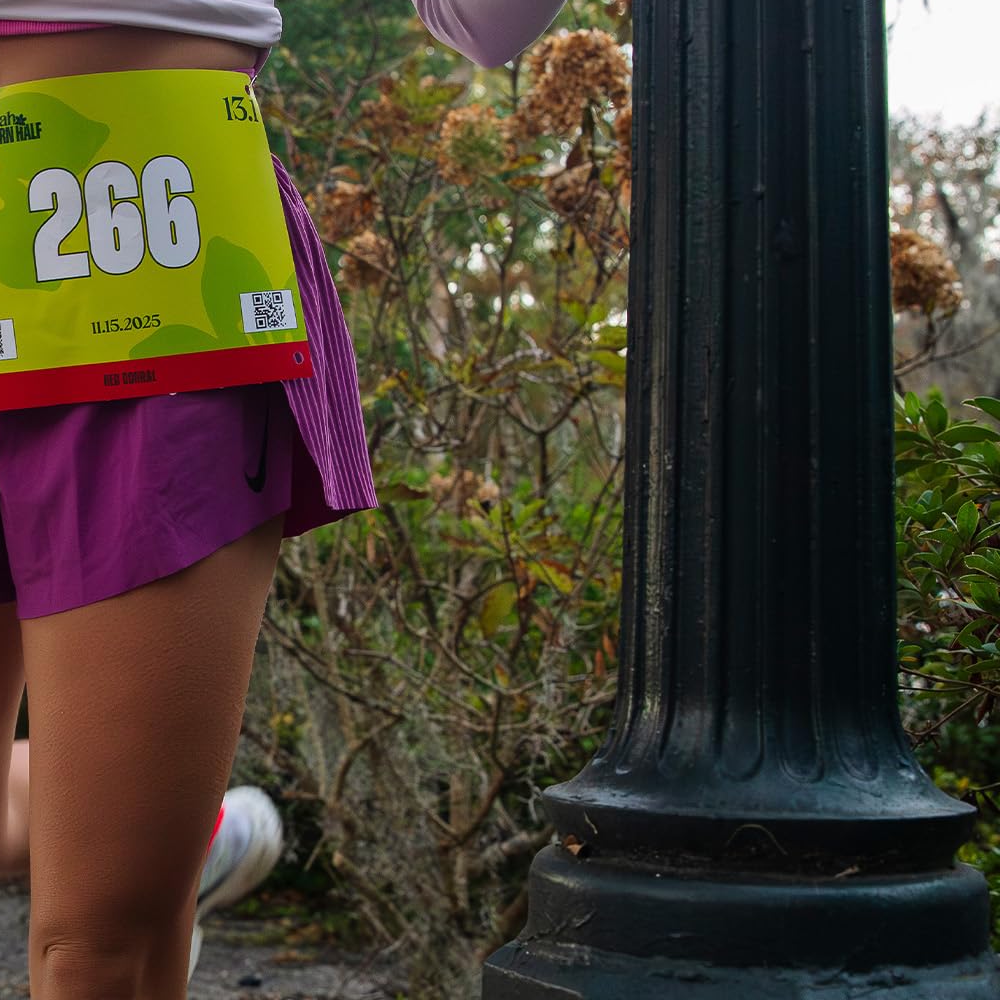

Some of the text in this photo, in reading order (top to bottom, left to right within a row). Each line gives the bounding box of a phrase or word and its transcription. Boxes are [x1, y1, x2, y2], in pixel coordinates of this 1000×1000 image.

[222, 96, 259, 122] 13.1
[15, 122, 42, 142] HALF
[28, 155, 201, 283] 266
[91, 314, 161, 334] 11.15.2025
